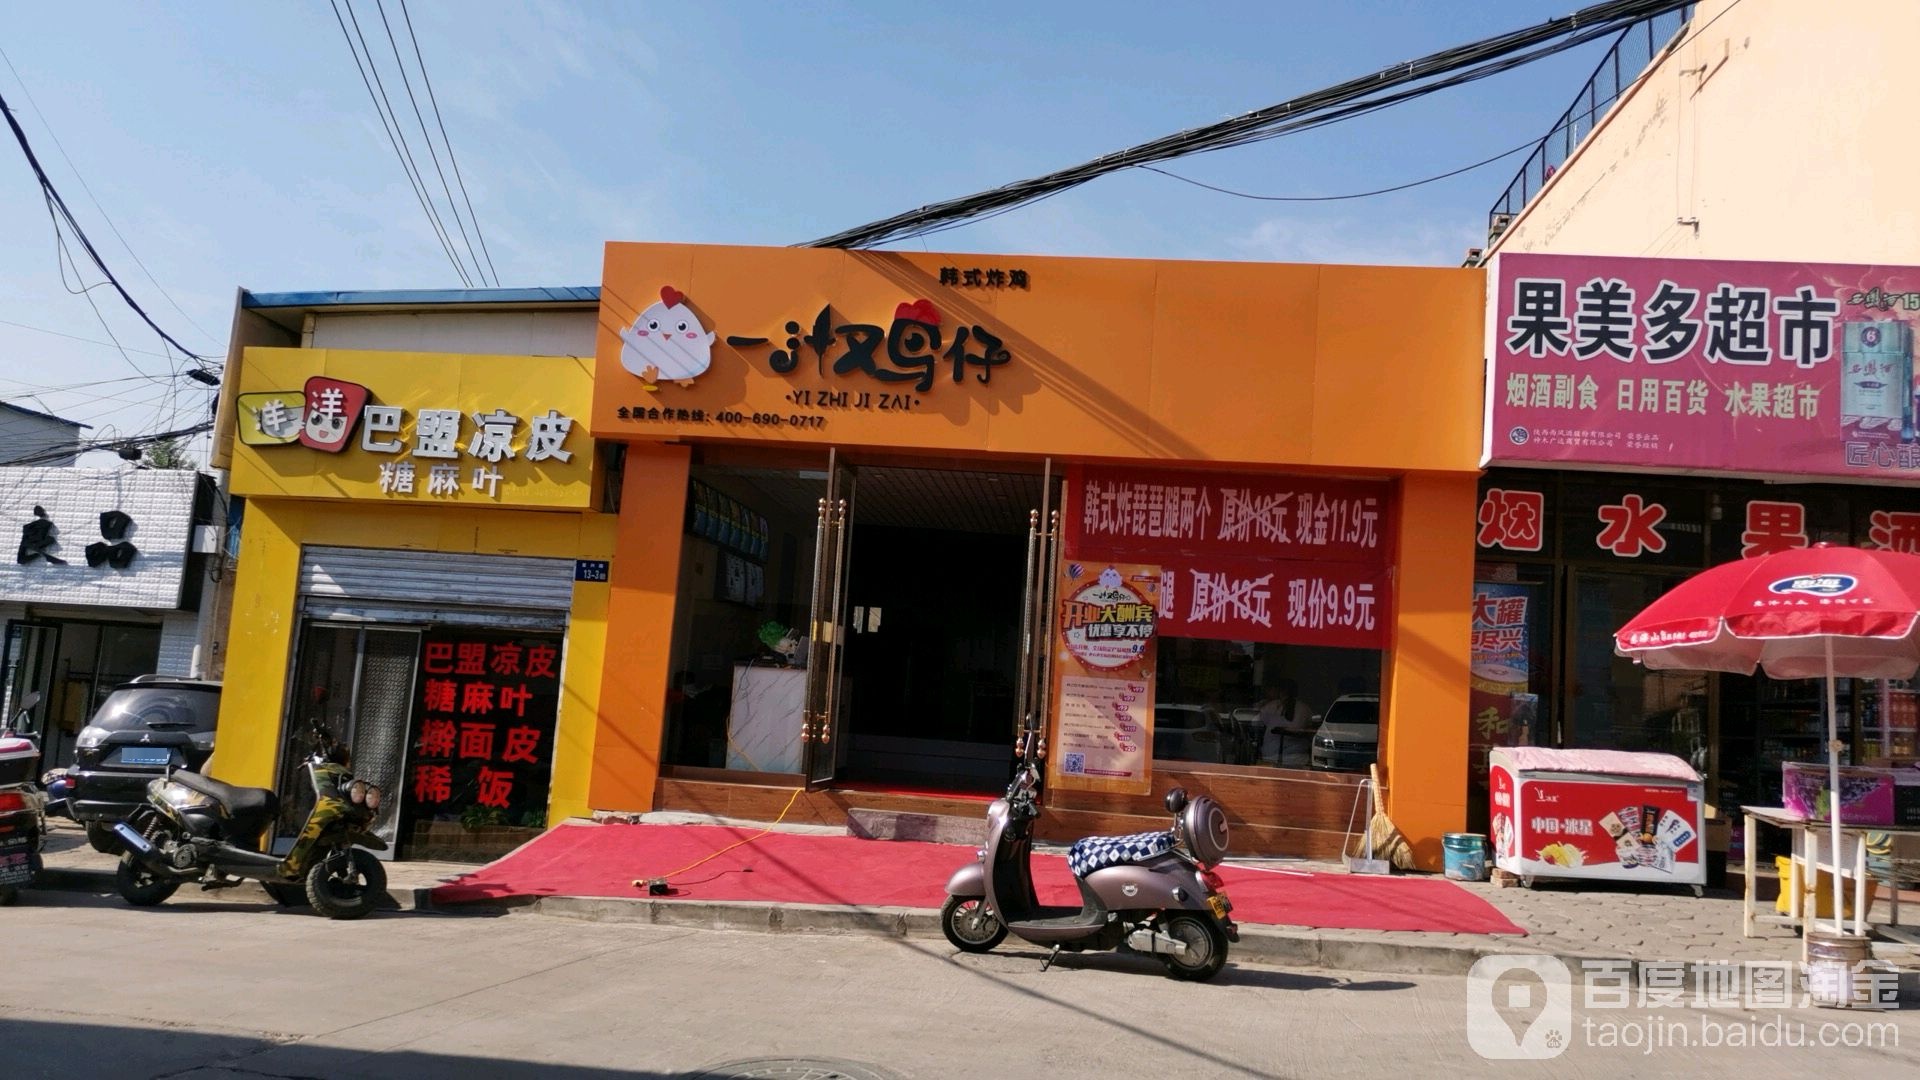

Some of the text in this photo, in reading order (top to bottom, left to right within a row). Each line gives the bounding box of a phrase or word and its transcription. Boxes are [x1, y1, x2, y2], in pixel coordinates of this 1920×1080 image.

[938, 267, 1028, 290] 韩式炸鸡
[1505, 276, 1840, 369] 果美多超市
[792, 390, 912, 411] YI ZHI JI ZAI
[1506, 373, 1820, 420] 烟酒副食 日用百货 水果超市
[362, 404, 573, 463] 巴盟凉皮
[379, 462, 504, 499] 糖麻叶
[1083, 480, 1213, 541] 韩式炸琵琶腿两个
[1296, 491, 1379, 548] 现金11.9元
[1063, 600, 1153, 629] 开业大酬宾
[1287, 577, 1376, 631] 现价9.9元
[1088, 623, 1153, 639] 优惠享不停
[424, 641, 556, 678] 巴盟凉皮
[424, 678, 533, 717] 糖麻叶
[419, 719, 541, 764] 擀面皮
[415, 765, 514, 808] 稀饭
